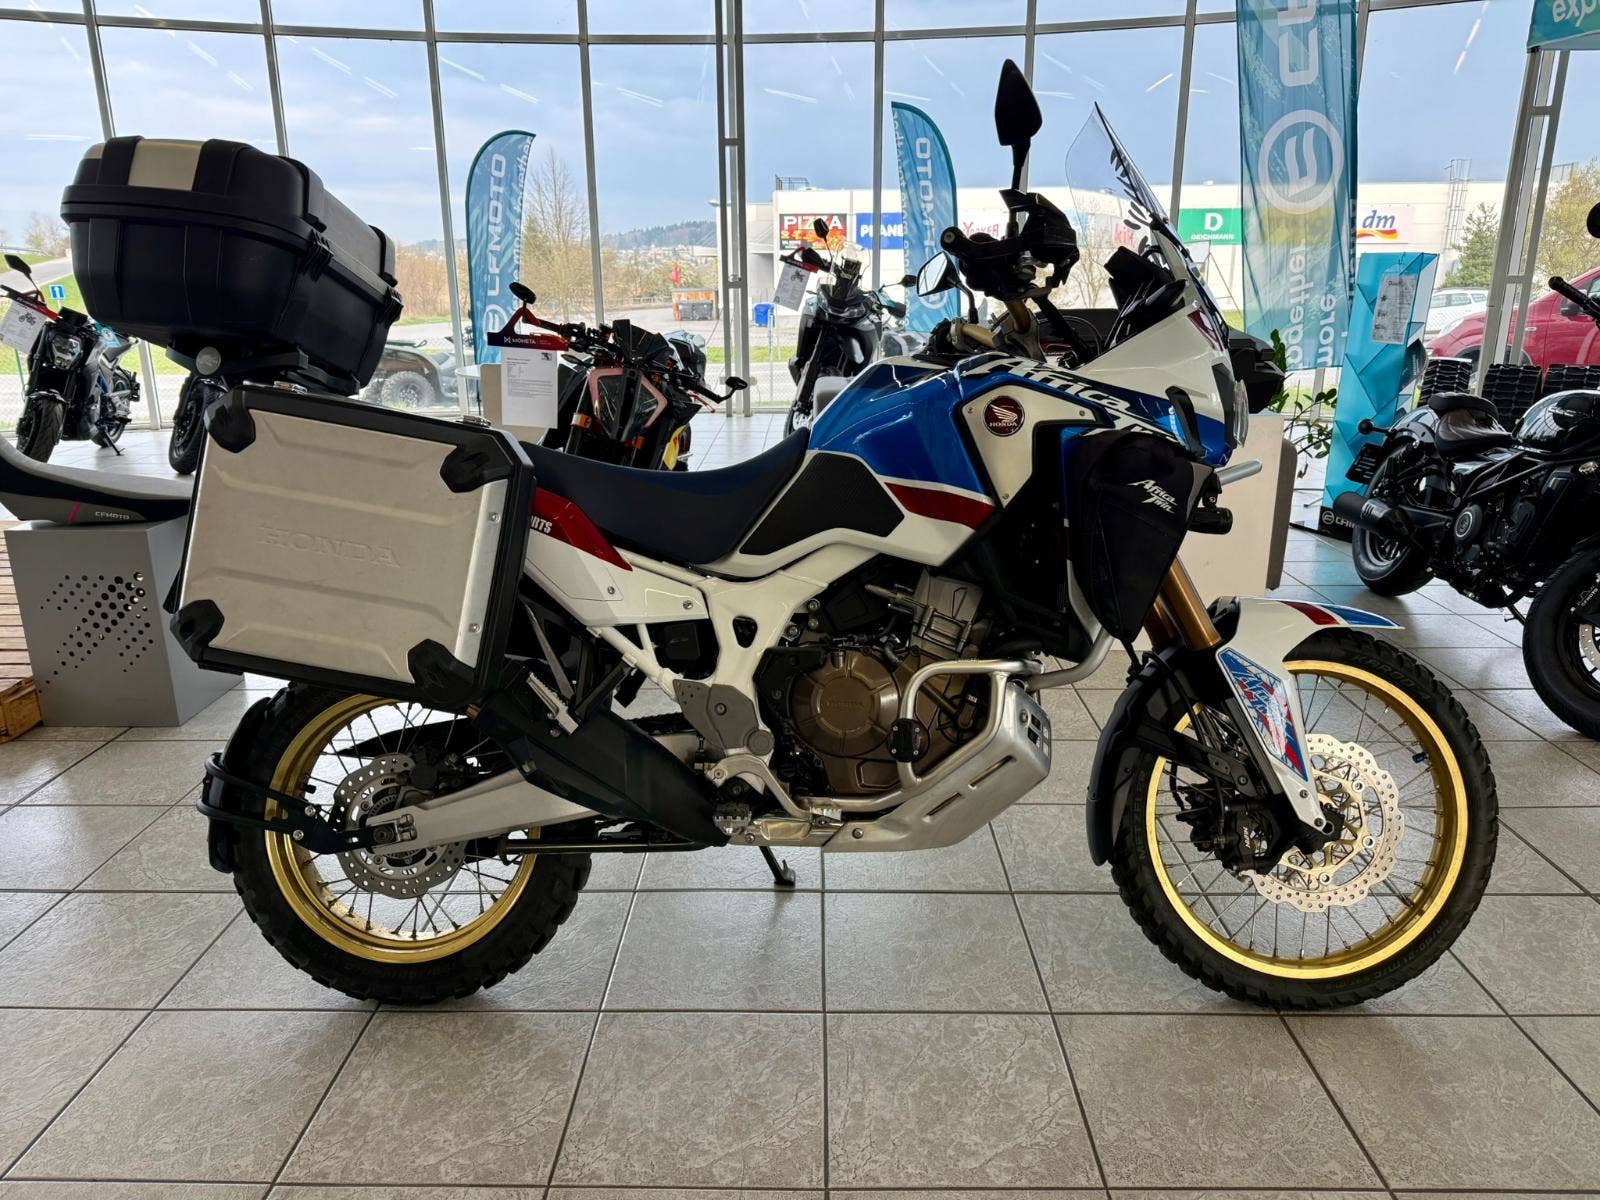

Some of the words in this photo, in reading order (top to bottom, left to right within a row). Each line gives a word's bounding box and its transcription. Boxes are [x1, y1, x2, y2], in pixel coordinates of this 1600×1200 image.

[1553, 0, 1600, 27] exp
[487, 153, 506, 296] CFMOTO
[1204, 212, 1224, 231] D
[1362, 209, 1396, 229] dm
[1127, 479, 1178, 506] Africa
[1141, 492, 1175, 514] Twin
[95, 511, 130, 520] CFMOTO
[531, 515, 553, 534] RTS
[257, 524, 401, 569] HONDA
